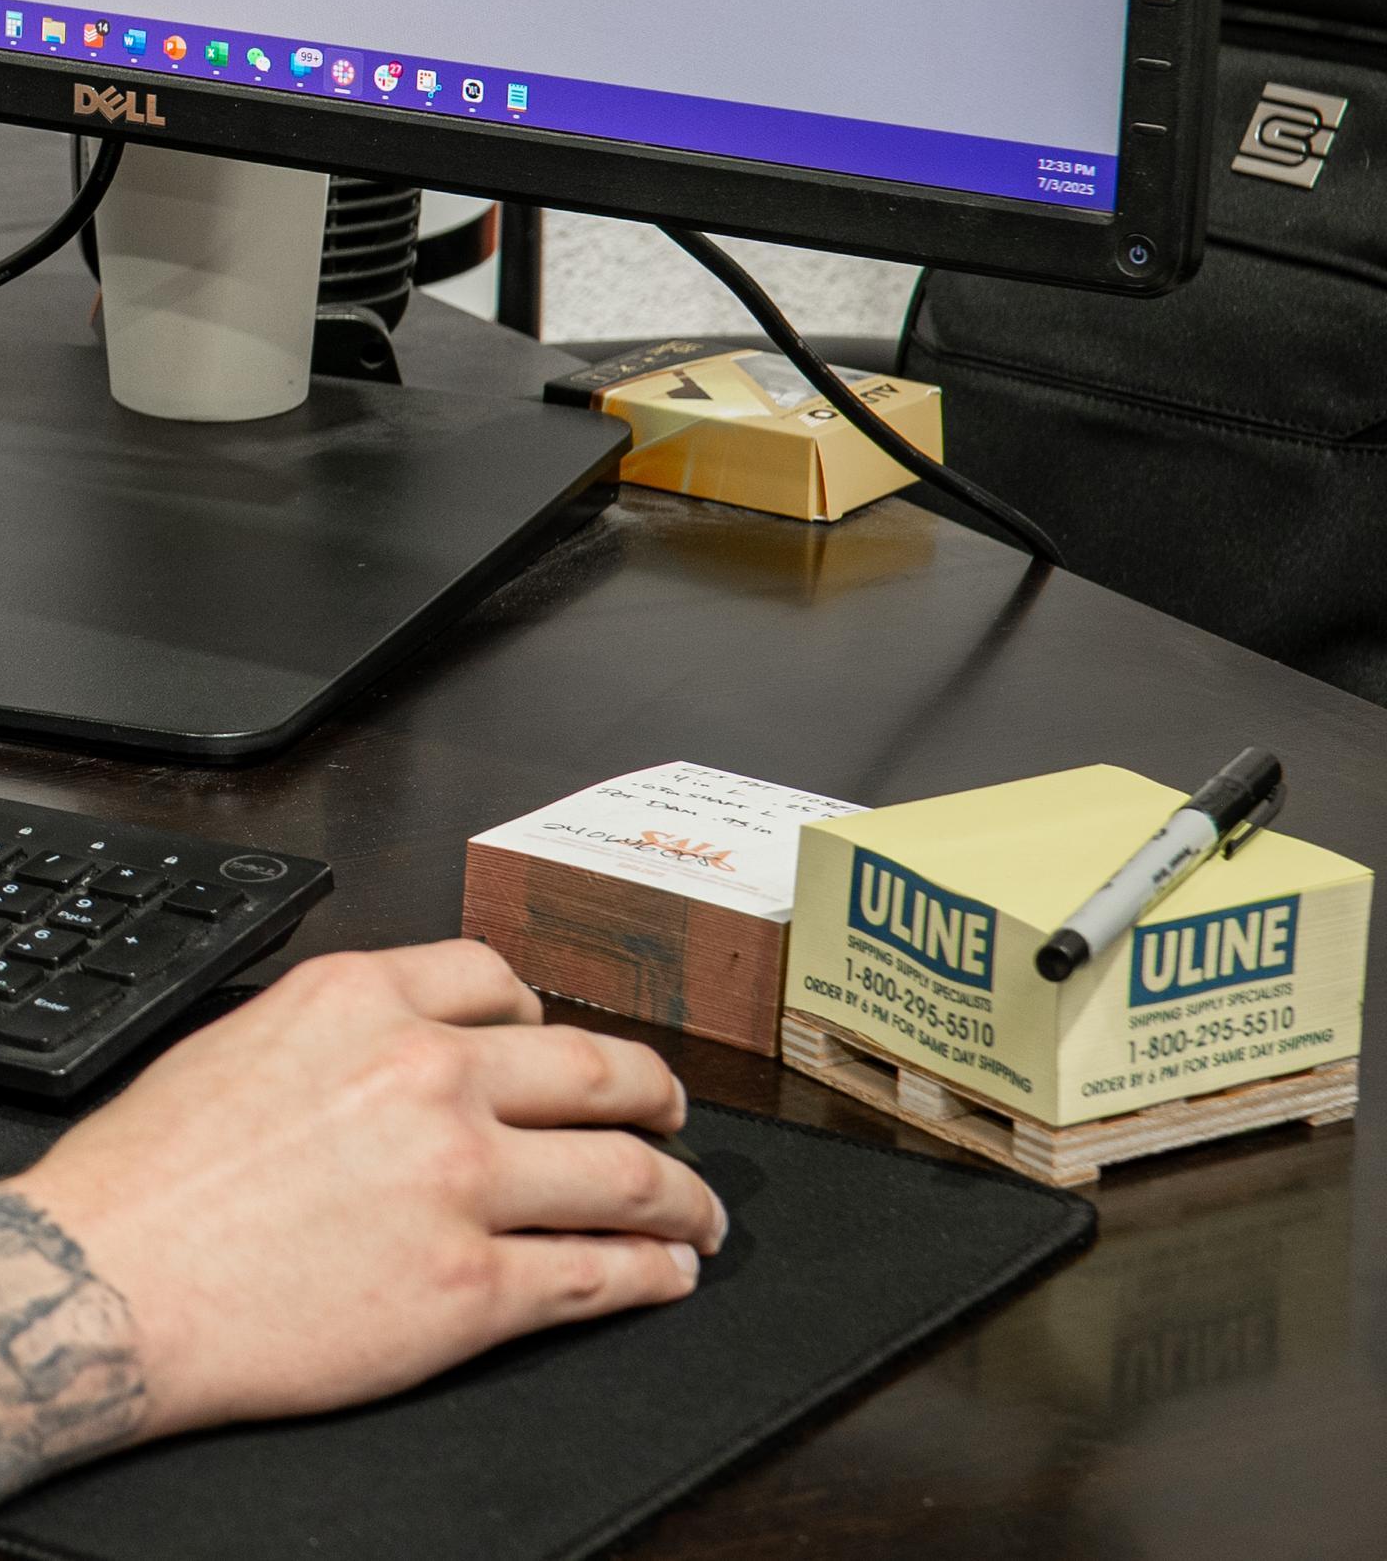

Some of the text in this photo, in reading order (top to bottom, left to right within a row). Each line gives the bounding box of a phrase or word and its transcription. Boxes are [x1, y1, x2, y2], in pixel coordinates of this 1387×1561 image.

[97, 22, 109, 33] 14
[301, 51, 319, 64] 99+
[389, 63, 401, 75] 27
[74, 83, 166, 126] DELL
[1037, 177, 1095, 195] 7/3/2025
[1038, 158, 1095, 177] 12:33 PM
[860, 863, 988, 976] ULINE
[848, 935, 992, 1013] SHIPPING SUPPLY SPECIALISTS
[1140, 904, 1291, 993] ULINE
[846, 957, 994, 1047] 1-800-295-5510
[1129, 982, 1293, 1030] SHIPPING SUPPLY SPECIALISTS
[805, 975, 842, 1001] ORDER
[847, 991, 858, 1007] BY
[872, 1004, 888, 1024] PM
[892, 1014, 915, 1036] FOR
[918, 1030, 949, 1059] SAME
[953, 1047, 975, 1067] DAY
[979, 1053, 1032, 1093] SHIPPING
[1129, 1005, 1295, 1064] 1-800-295-5510
[1082, 1028, 1334, 1097] ORDER BY 6 PM FOR SAME DAY SHIPPING
